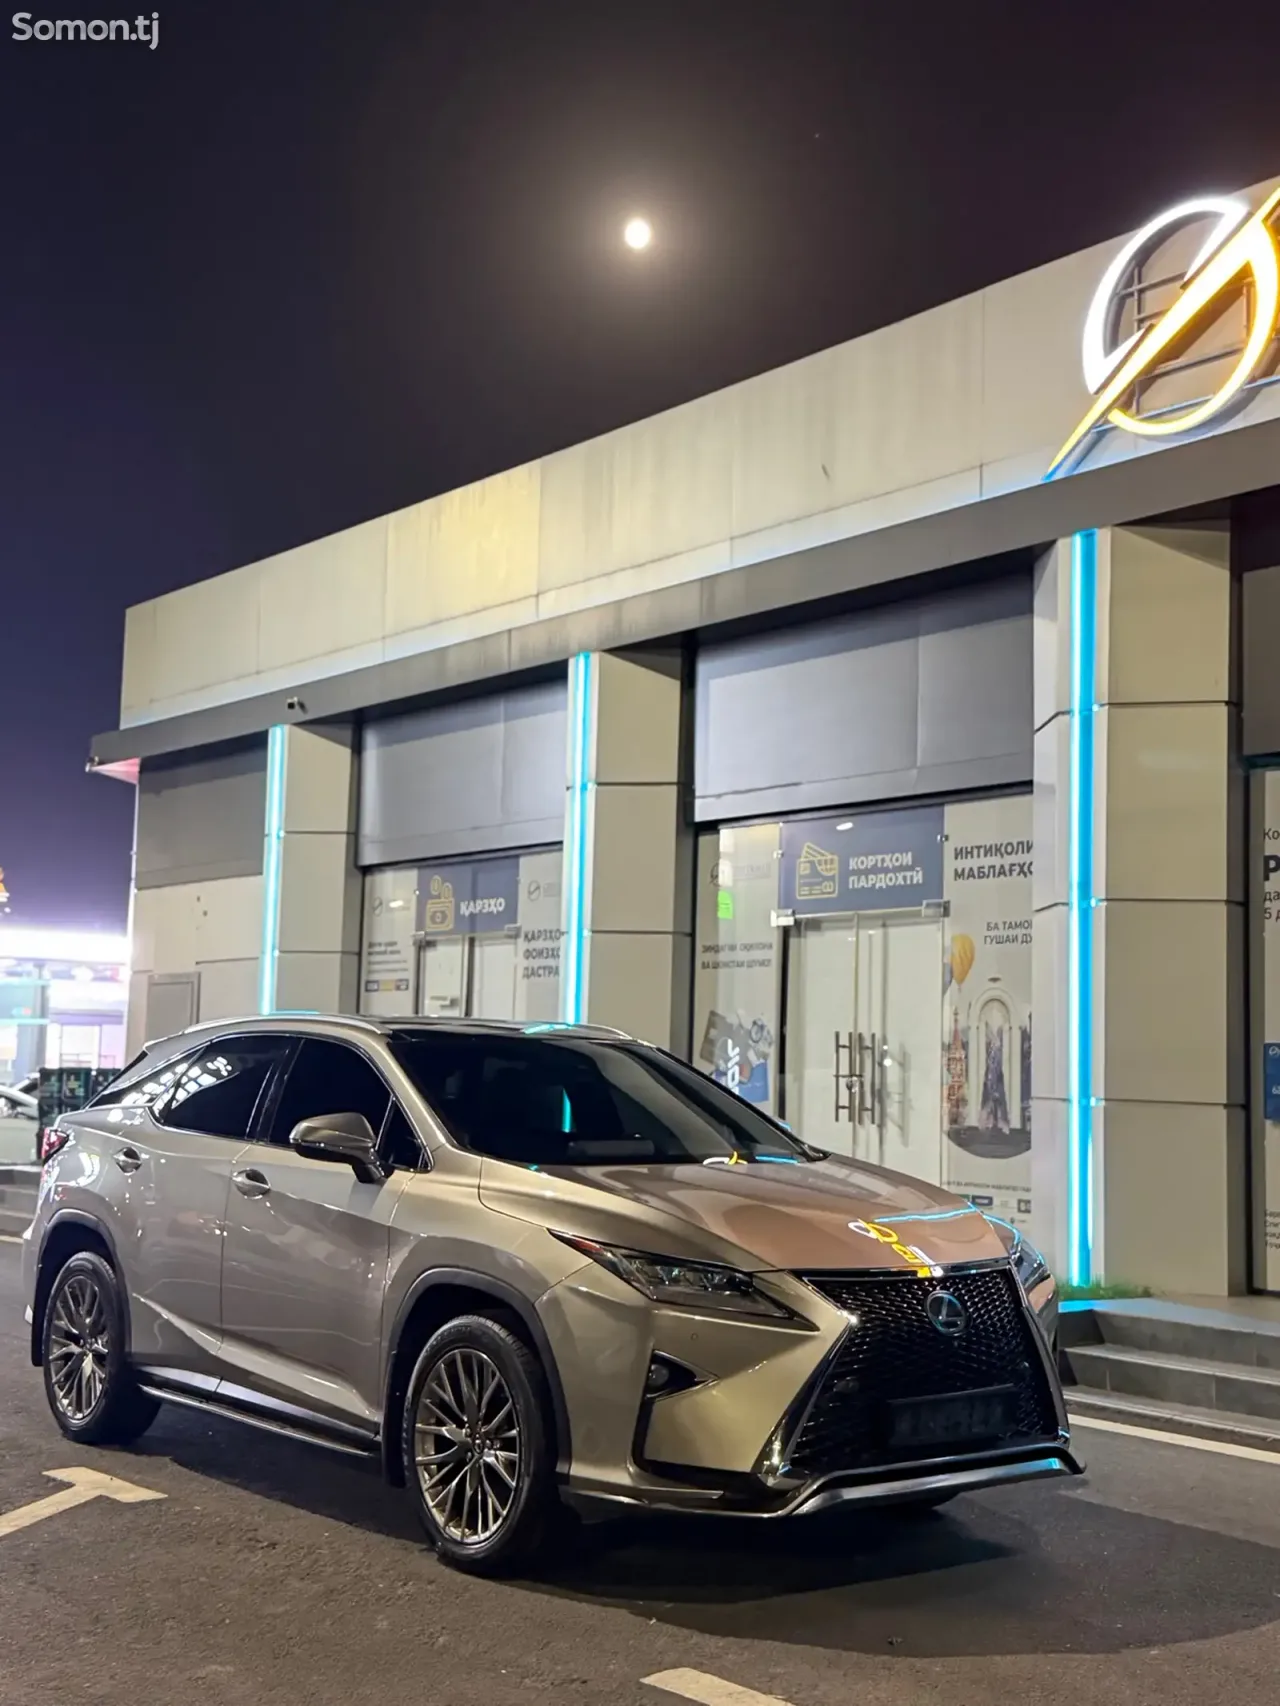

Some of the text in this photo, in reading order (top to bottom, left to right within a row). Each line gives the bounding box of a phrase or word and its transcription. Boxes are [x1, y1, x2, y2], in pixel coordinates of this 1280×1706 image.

[848, 851, 913, 871] КОРТҲОИ
[459, 897, 506, 918] ҚАРЗҲО
[986, 919, 1033, 932] БА ТАМО
